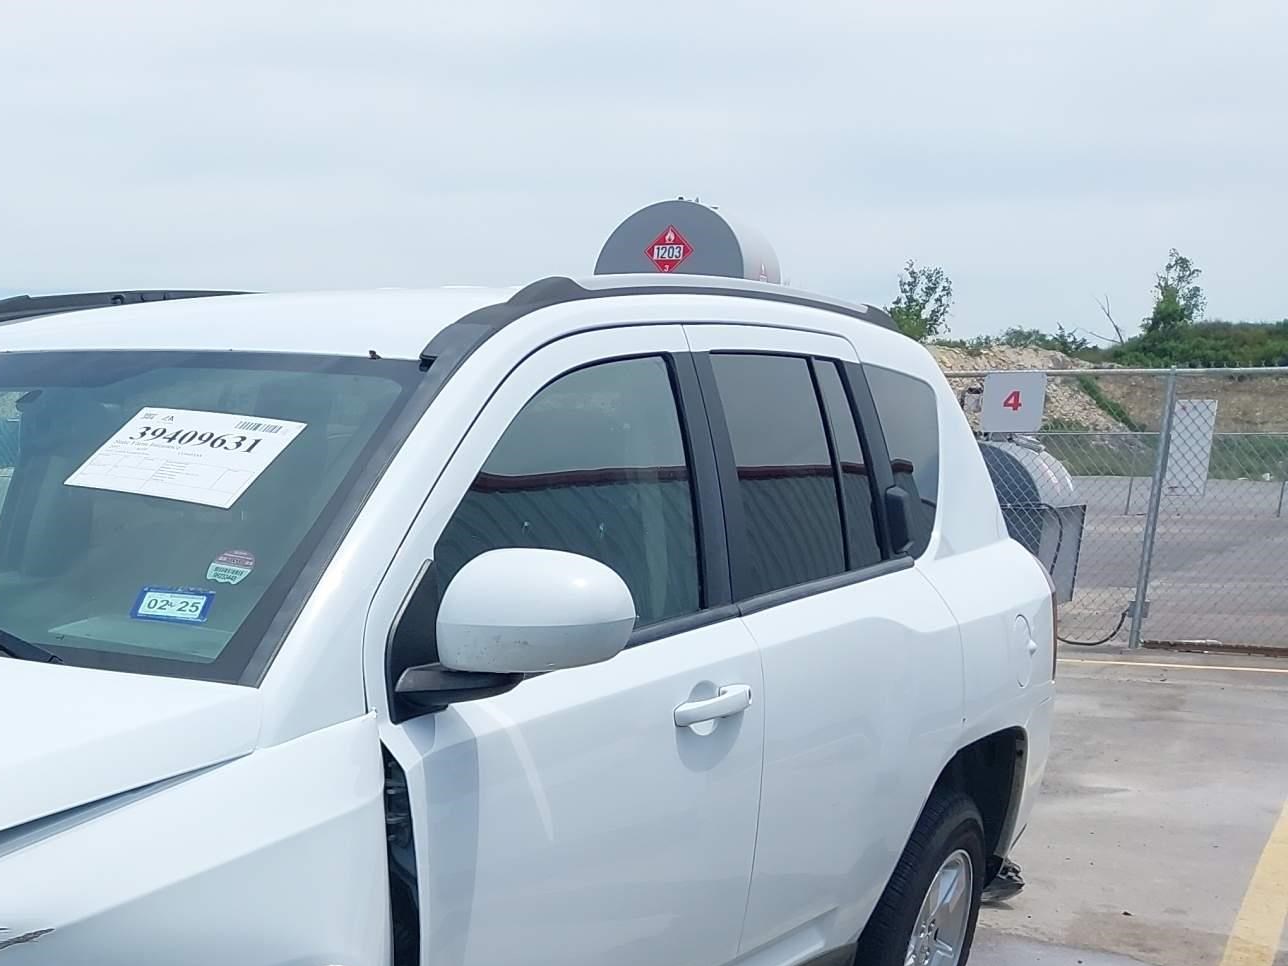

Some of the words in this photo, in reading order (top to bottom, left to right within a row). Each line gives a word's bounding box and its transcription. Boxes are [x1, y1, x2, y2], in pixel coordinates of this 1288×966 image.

[655, 246, 682, 259] 1203
[1003, 390, 1023, 411] 4
[129, 426, 264, 453] 39409631
[147, 598, 169, 611] 02
[176, 600, 201, 613] 25
